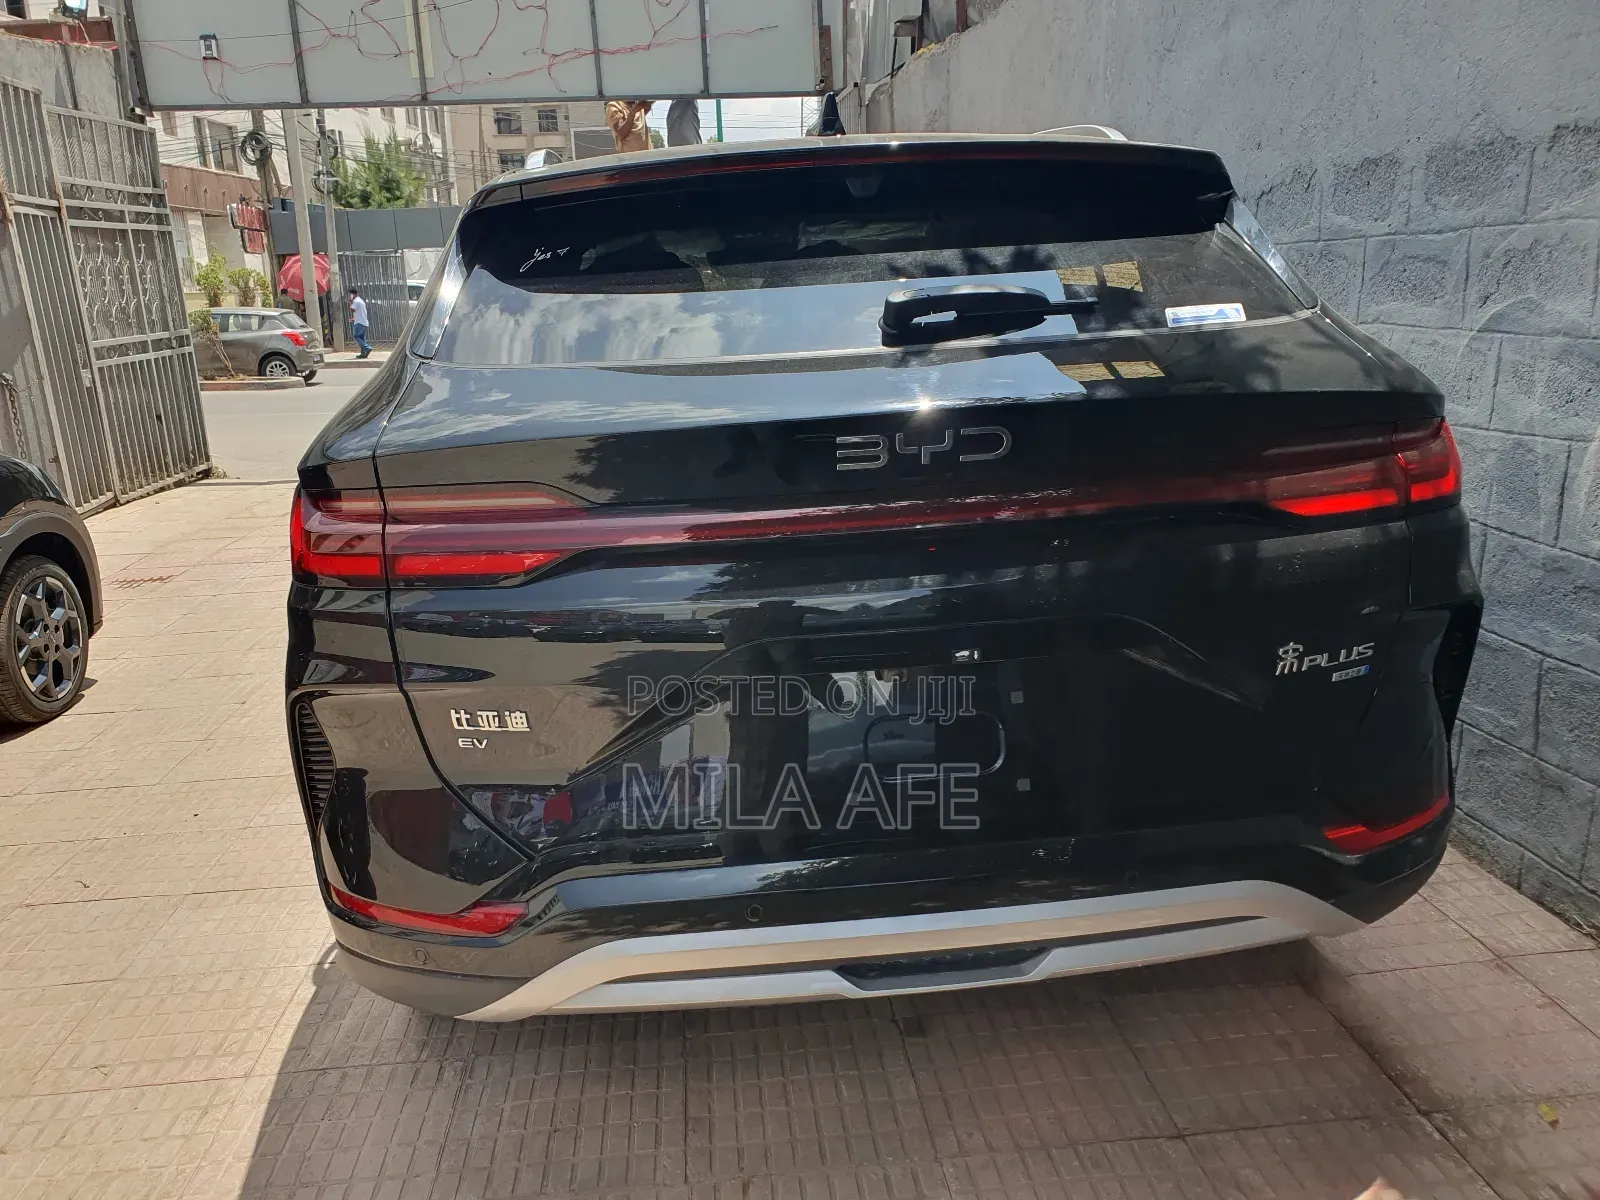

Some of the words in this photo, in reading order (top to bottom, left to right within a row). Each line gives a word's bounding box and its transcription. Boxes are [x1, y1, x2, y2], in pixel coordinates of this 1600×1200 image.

[836, 426, 1012, 471] BYD
[450, 709, 531, 732] 比亚迪
[458, 738, 488, 749] EV
